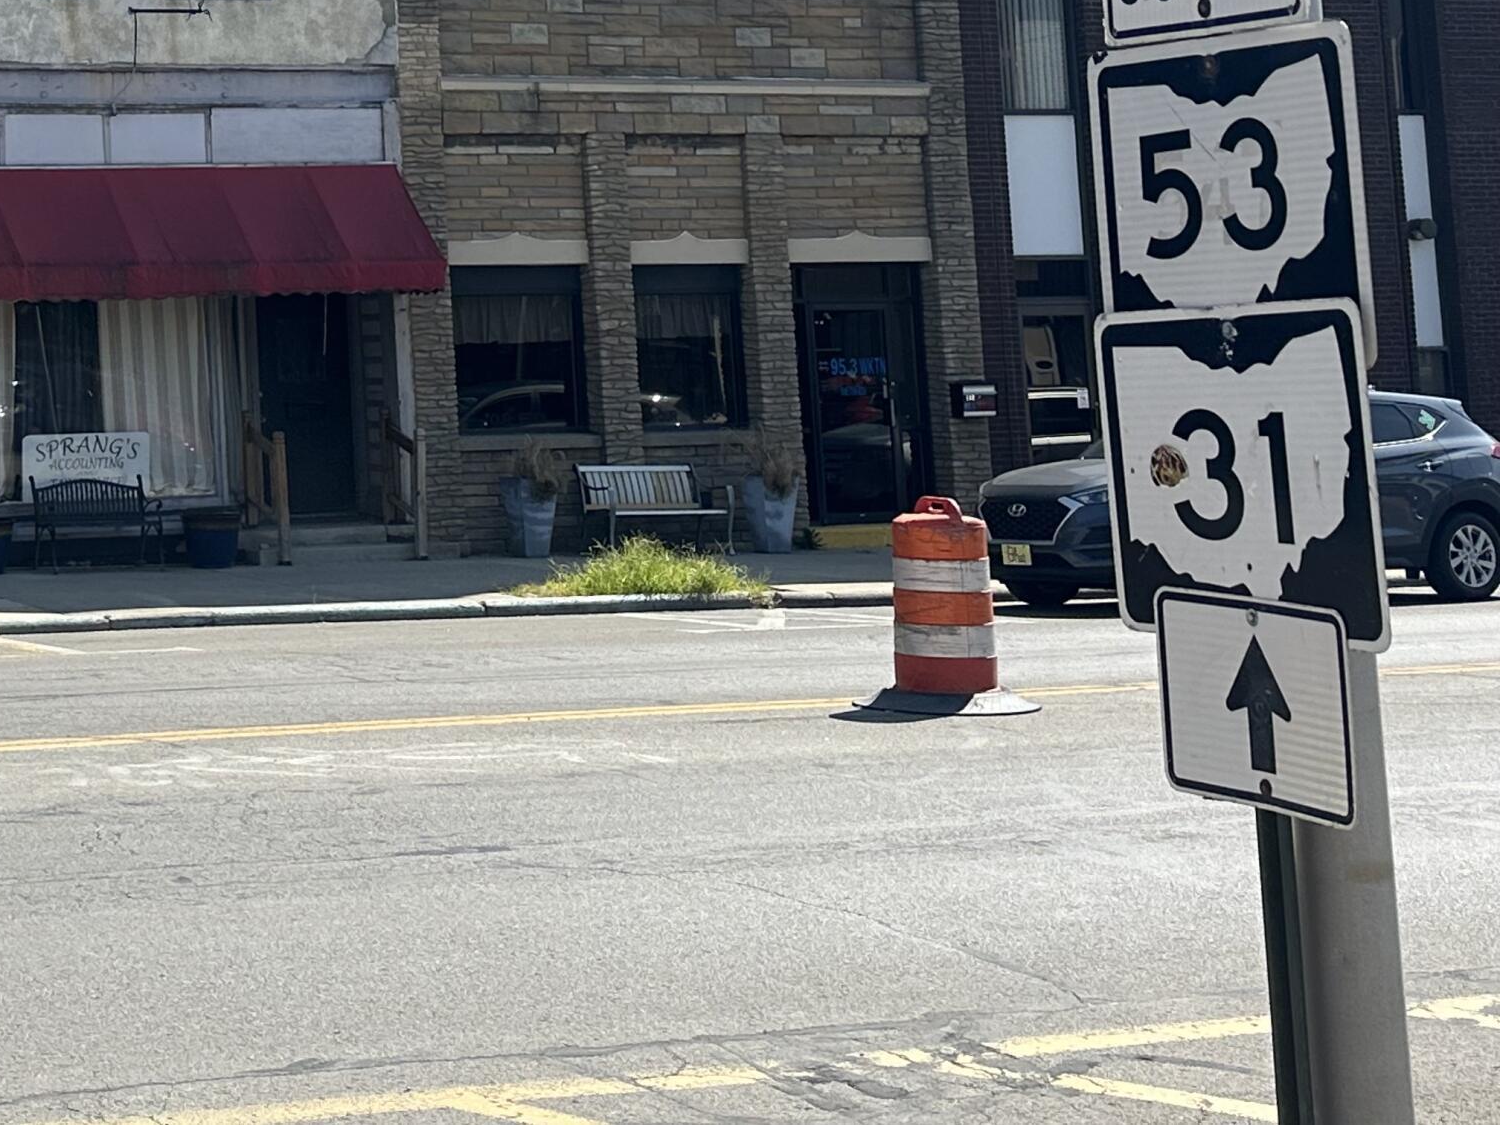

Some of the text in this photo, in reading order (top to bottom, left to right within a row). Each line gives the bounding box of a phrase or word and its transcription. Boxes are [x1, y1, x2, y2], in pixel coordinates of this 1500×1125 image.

[1138, 117, 1288, 260] 53
[830, 357, 858, 375] 95.3
[35, 435, 141, 463] SPRANG'S
[49, 456, 124, 471] ACCOUNTING
[1171, 408, 1296, 545] 31
